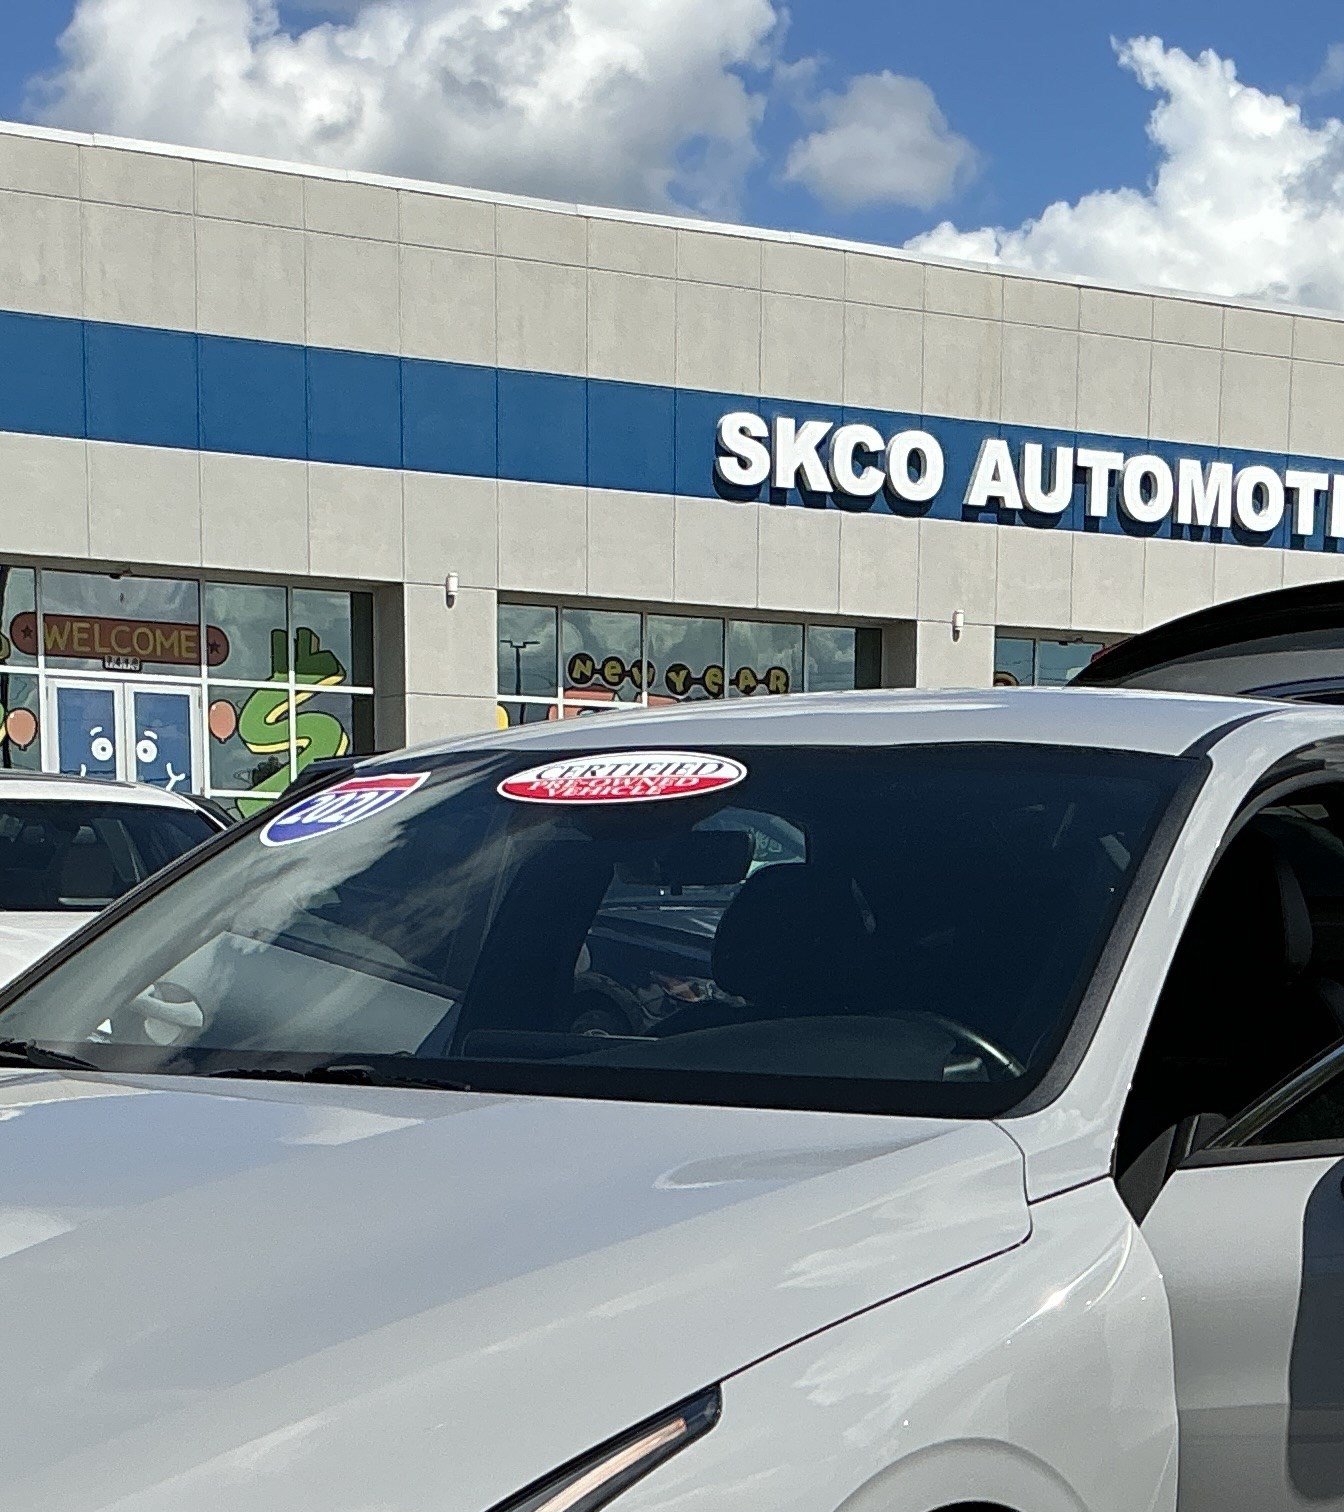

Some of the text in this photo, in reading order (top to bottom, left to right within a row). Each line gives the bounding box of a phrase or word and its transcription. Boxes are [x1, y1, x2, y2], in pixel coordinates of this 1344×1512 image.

[716, 411, 944, 503] SKCO
[44, 620, 199, 659] WELCOME
[536, 762, 724, 780] CERTIFIED
[527, 777, 700, 794] PRE-OWNED
[547, 785, 663, 798] VEHICLE
[275, 791, 395, 825] 2021
